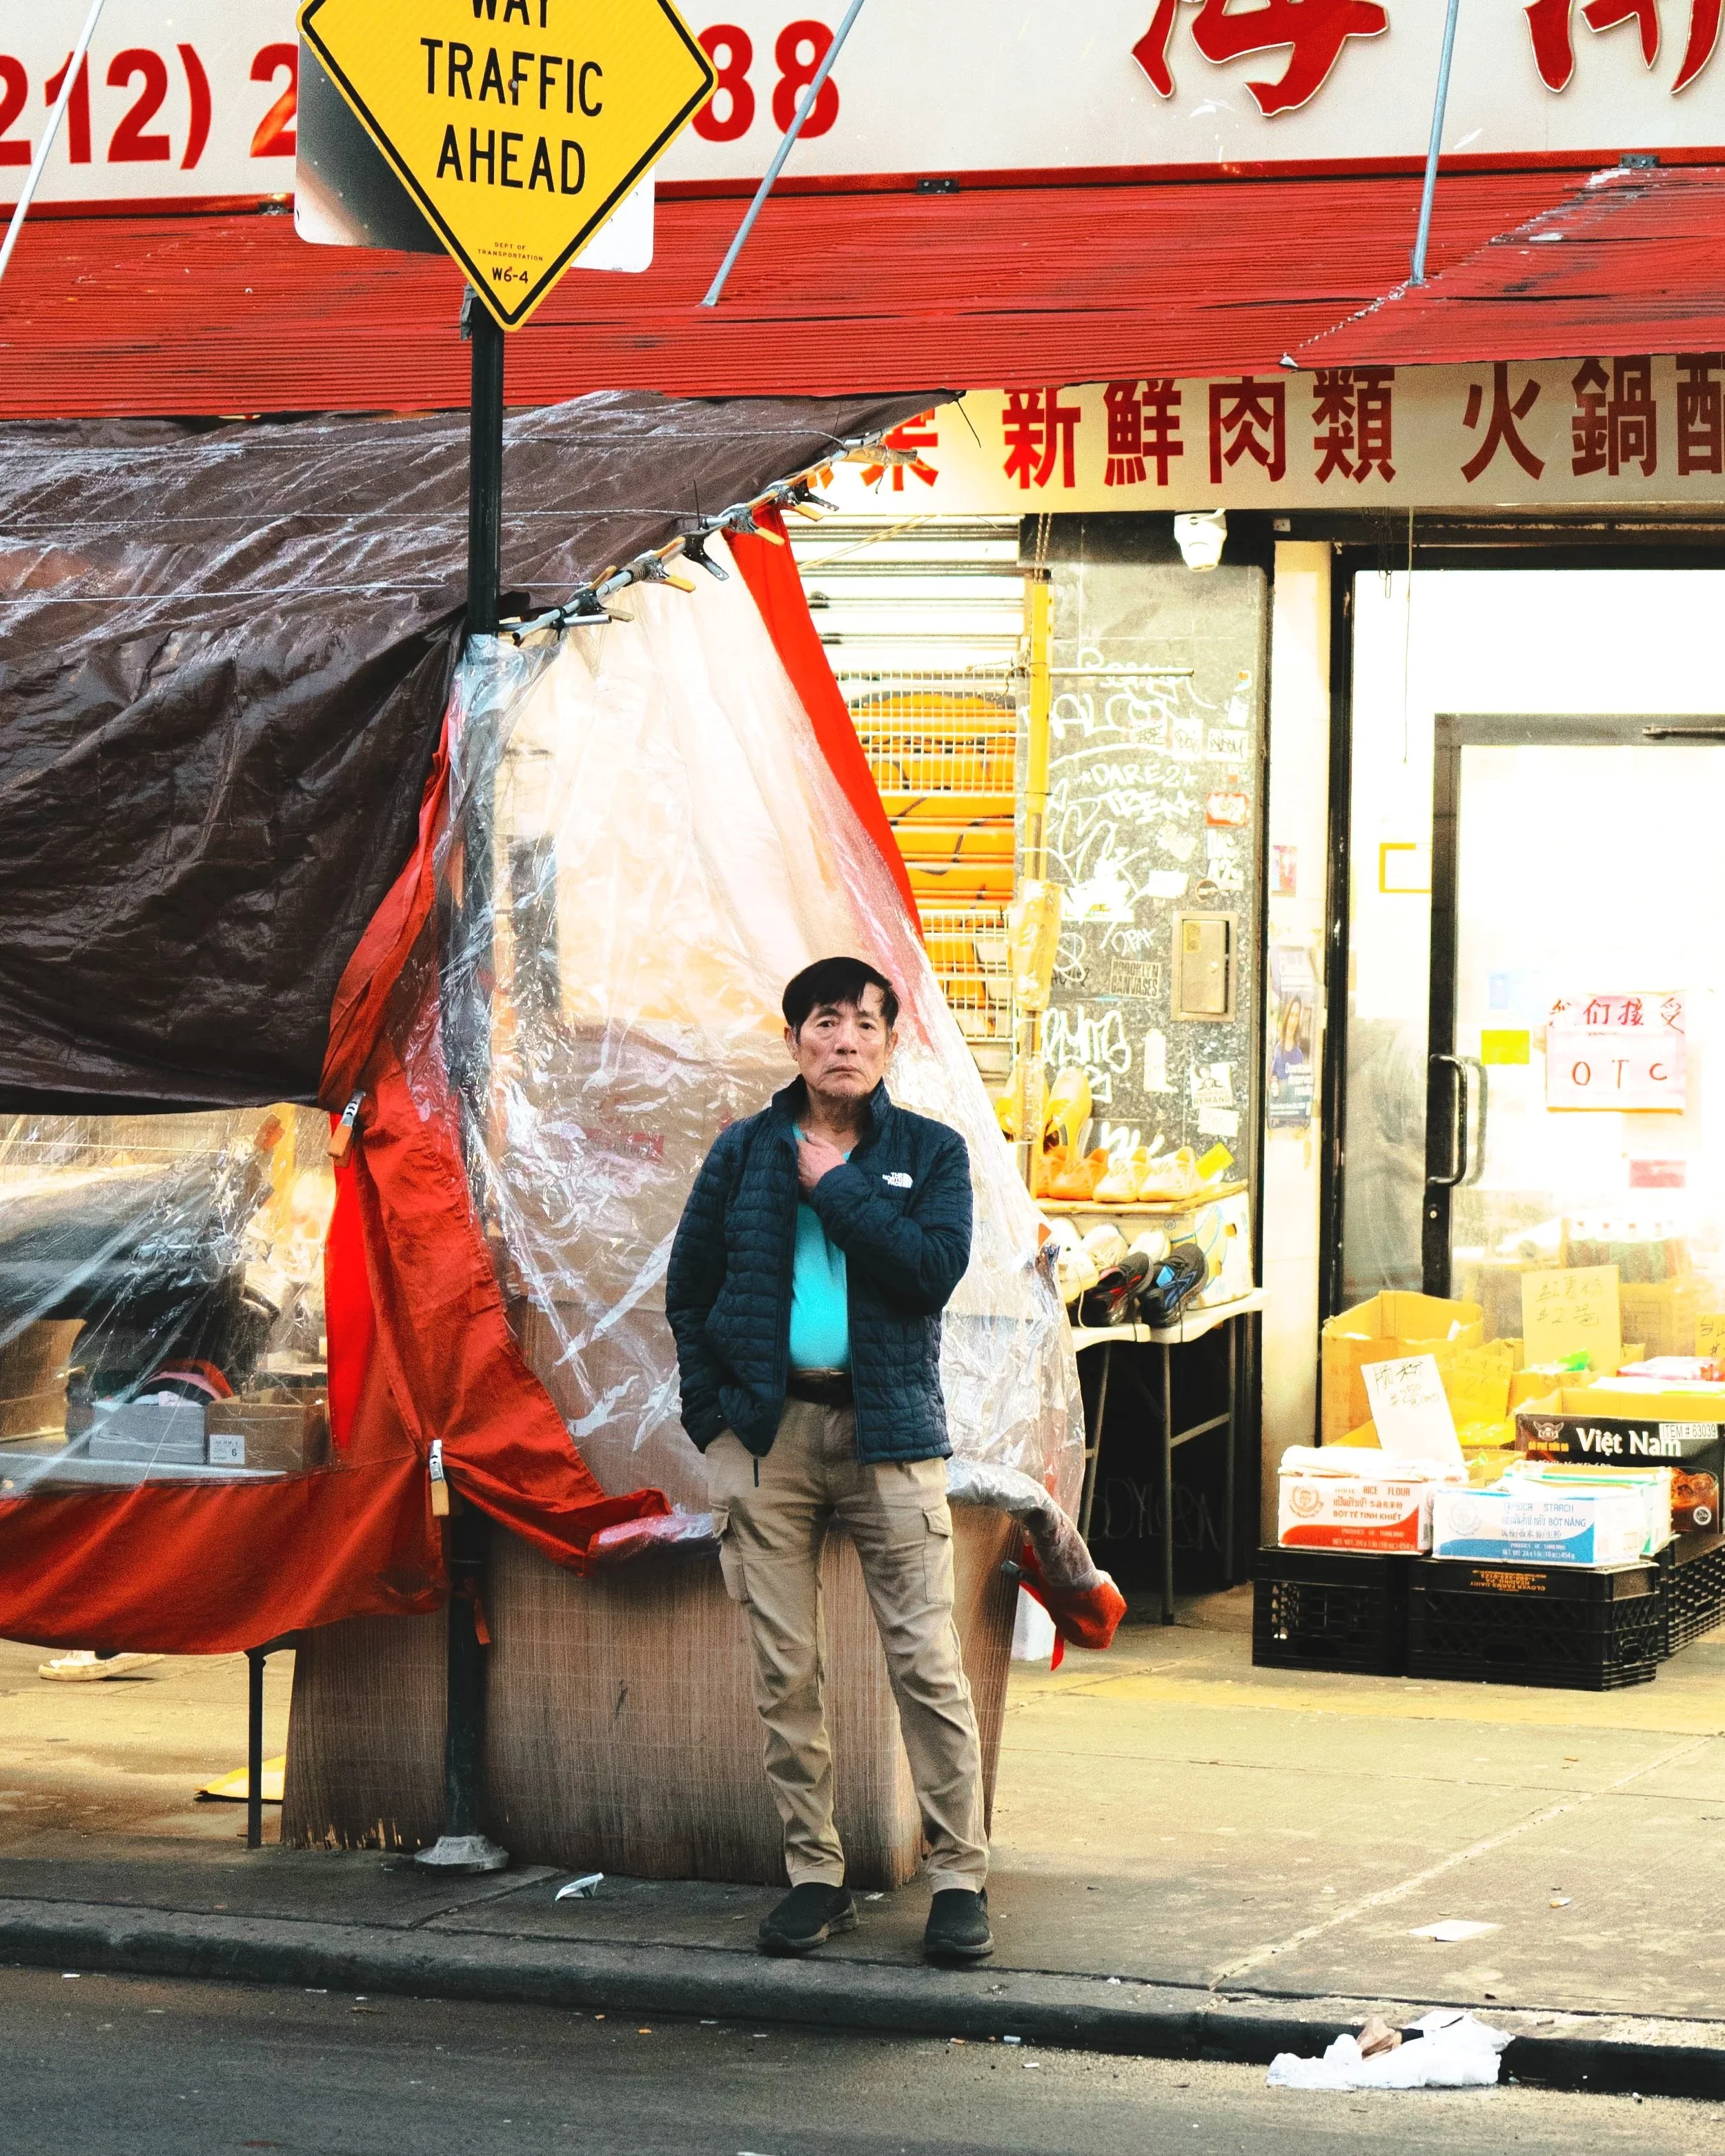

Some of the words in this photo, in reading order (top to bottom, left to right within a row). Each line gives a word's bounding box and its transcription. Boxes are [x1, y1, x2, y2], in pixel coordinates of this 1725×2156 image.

[420, 37, 603, 117] TRAFFIC
[436, 124, 586, 195] AHEAD
[477, 248, 543, 261] TRANSPORTATION
[492, 266, 529, 284] W6-4
[1003, 367, 1397, 490] 新鮮肉類
[1662, 1423, 1684, 1437] ITEM
[1685, 1424, 1690, 1436] #
[1693, 1424, 1716, 1437] 63039
[1576, 1427, 1623, 1456] Việt
[1628, 1430, 1682, 1457] Nam
[1388, 1487, 1410, 1496] FLOUR
[1543, 1503, 1574, 1513] STARCH
